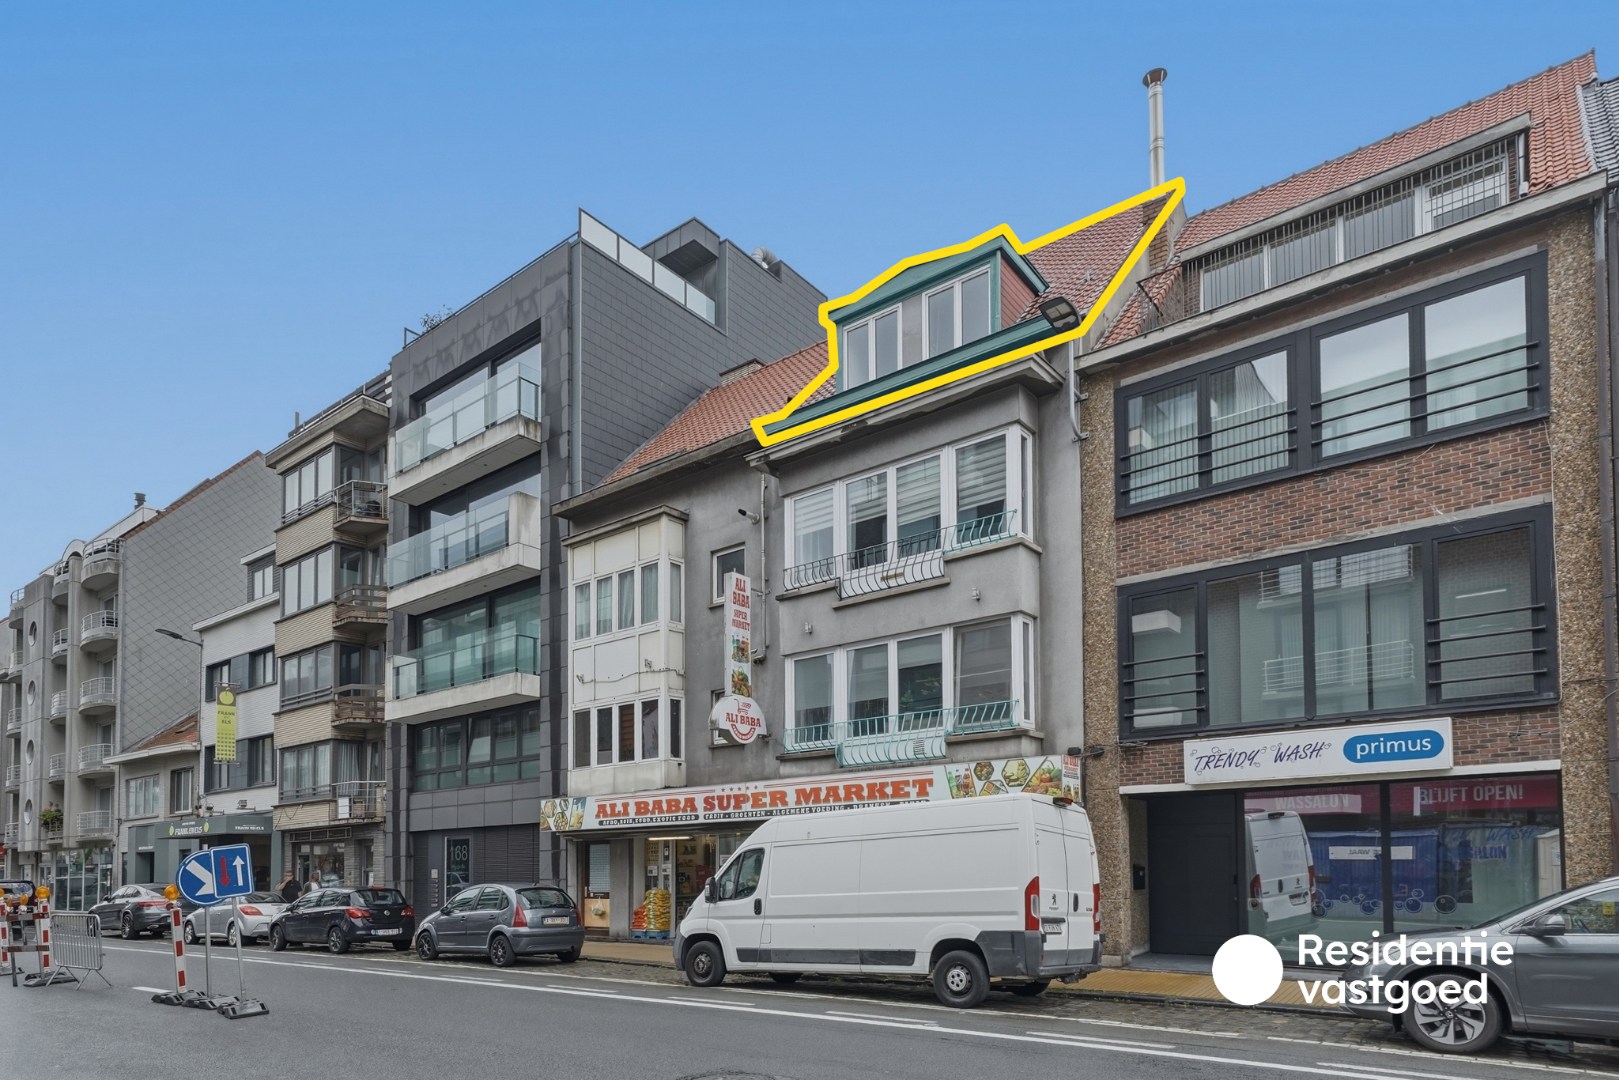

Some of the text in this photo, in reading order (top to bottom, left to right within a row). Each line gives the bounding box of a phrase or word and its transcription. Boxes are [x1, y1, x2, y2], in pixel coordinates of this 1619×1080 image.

[735, 577, 746, 592] ALI
[732, 591, 750, 608] BABA
[725, 712, 761, 728] ALI BABA
[1194, 741, 1325, 771] TRENDY WASH
[1356, 737, 1432, 759] primus
[595, 778, 934, 819] ALI BABA SUPER MARKET
[1275, 793, 1349, 810] WASSALON
[1420, 784, 1524, 804] BLIJFT OPEN!
[450, 845, 468, 861] 168
